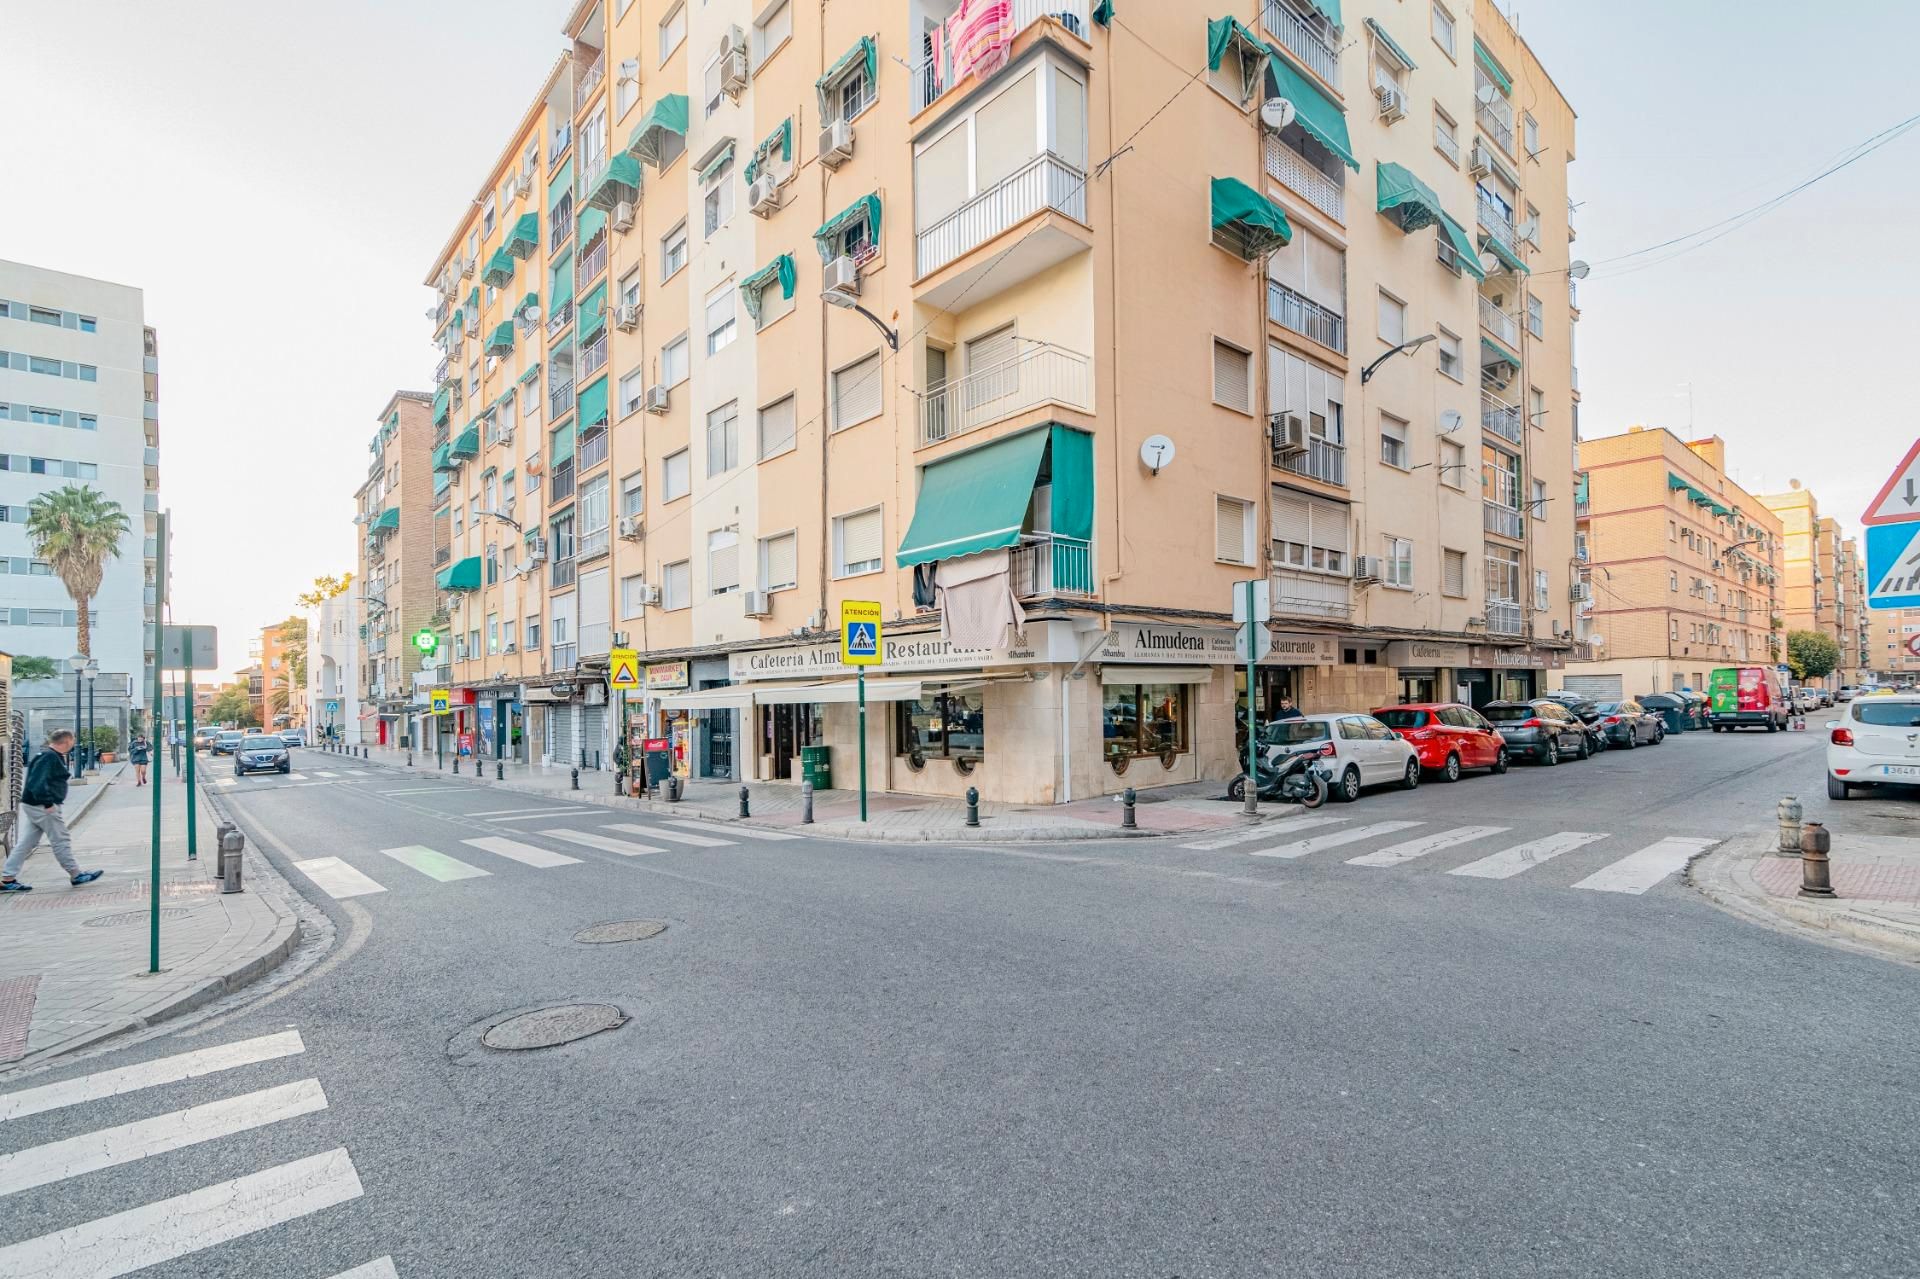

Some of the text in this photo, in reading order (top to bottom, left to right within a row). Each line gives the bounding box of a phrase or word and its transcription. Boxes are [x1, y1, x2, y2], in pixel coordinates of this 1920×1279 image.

[1135, 629, 1205, 650] Almudena
[1271, 640, 1315, 653] staurante
[750, 652, 804, 670] Cafeteria
[886, 639, 992, 660] Restaur
[1493, 648, 1528, 665] Almudena
